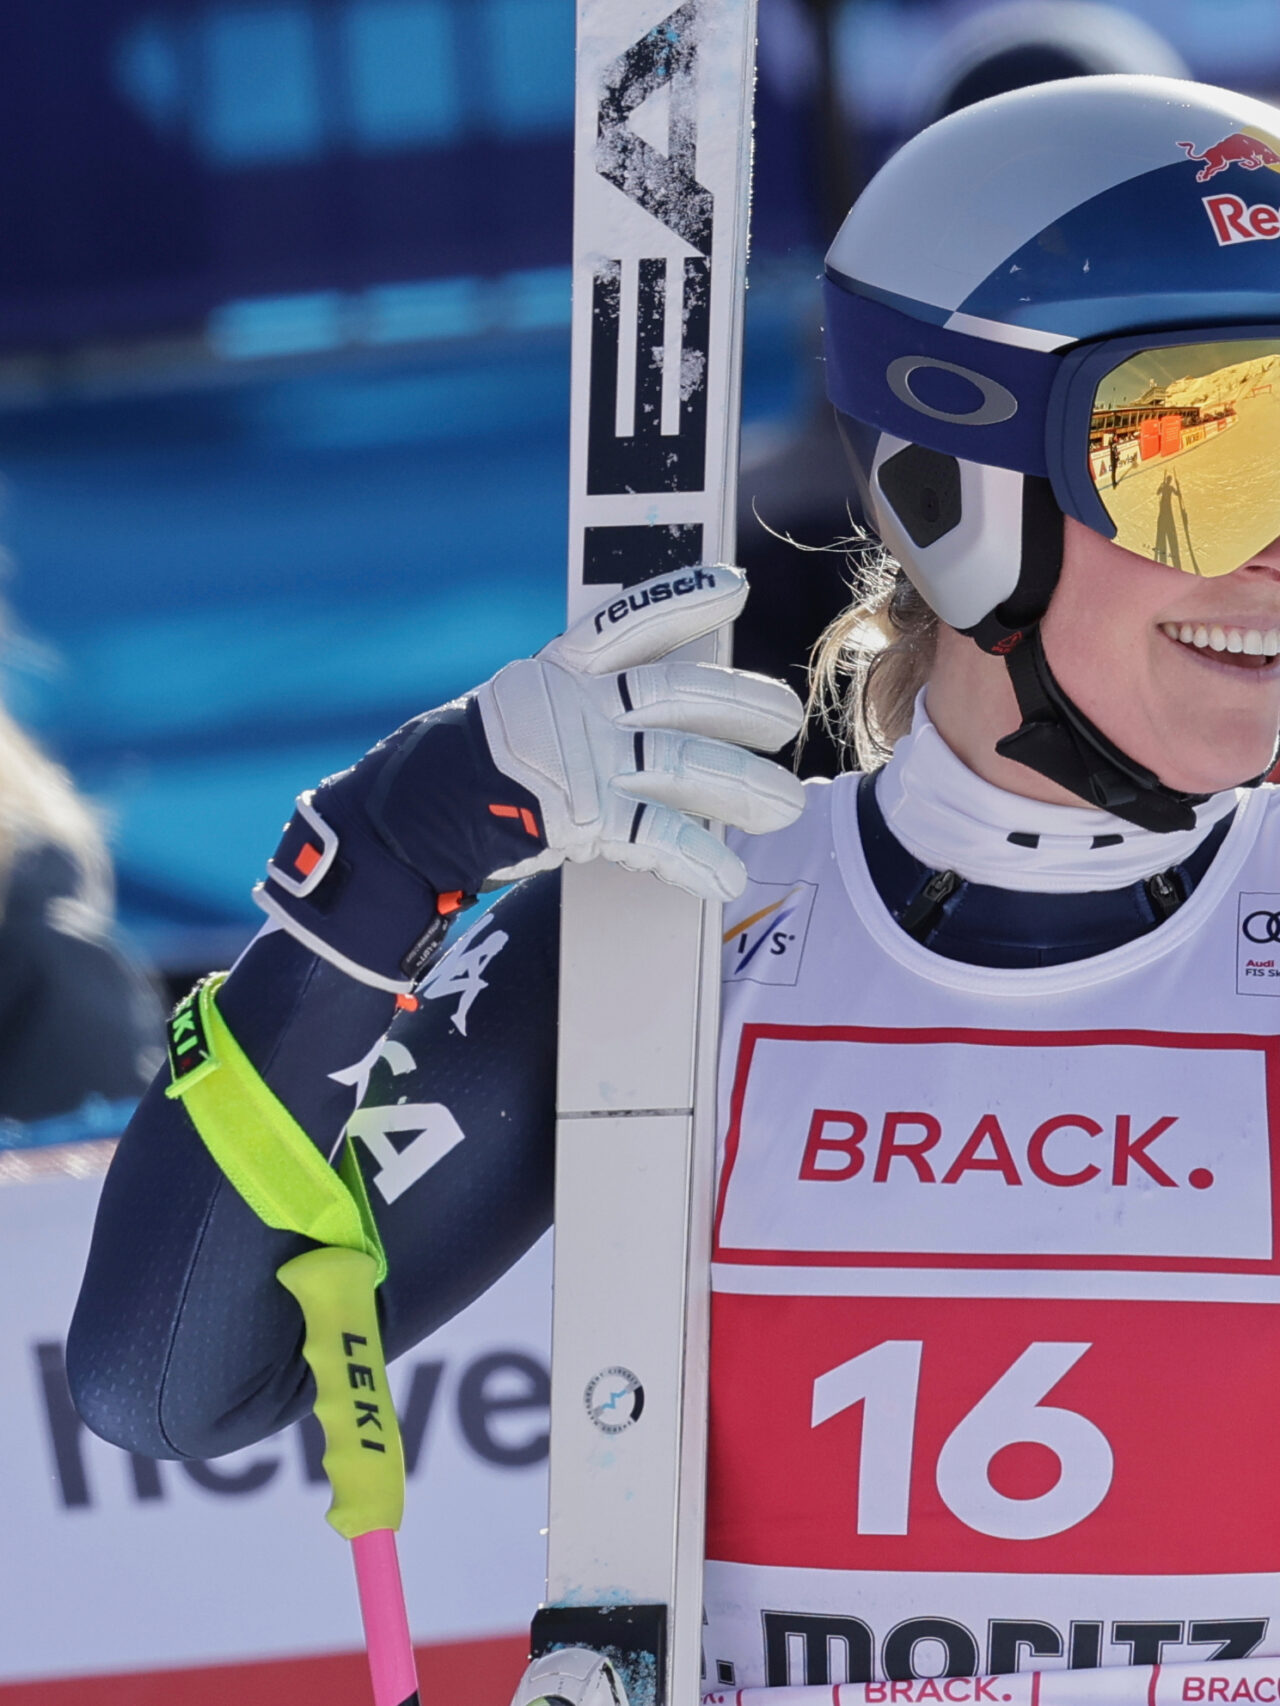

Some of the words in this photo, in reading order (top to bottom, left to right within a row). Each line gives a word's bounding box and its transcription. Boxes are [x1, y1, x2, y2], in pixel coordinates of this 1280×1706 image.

[594, 569, 716, 635] reusch
[1245, 968, 1265, 977] FIS
[1246, 959, 1275, 968] Audi
[798, 1108, 1214, 1189] BRACK.
[341, 1331, 386, 1453] LEKI
[810, 1339, 1114, 1540] 16
